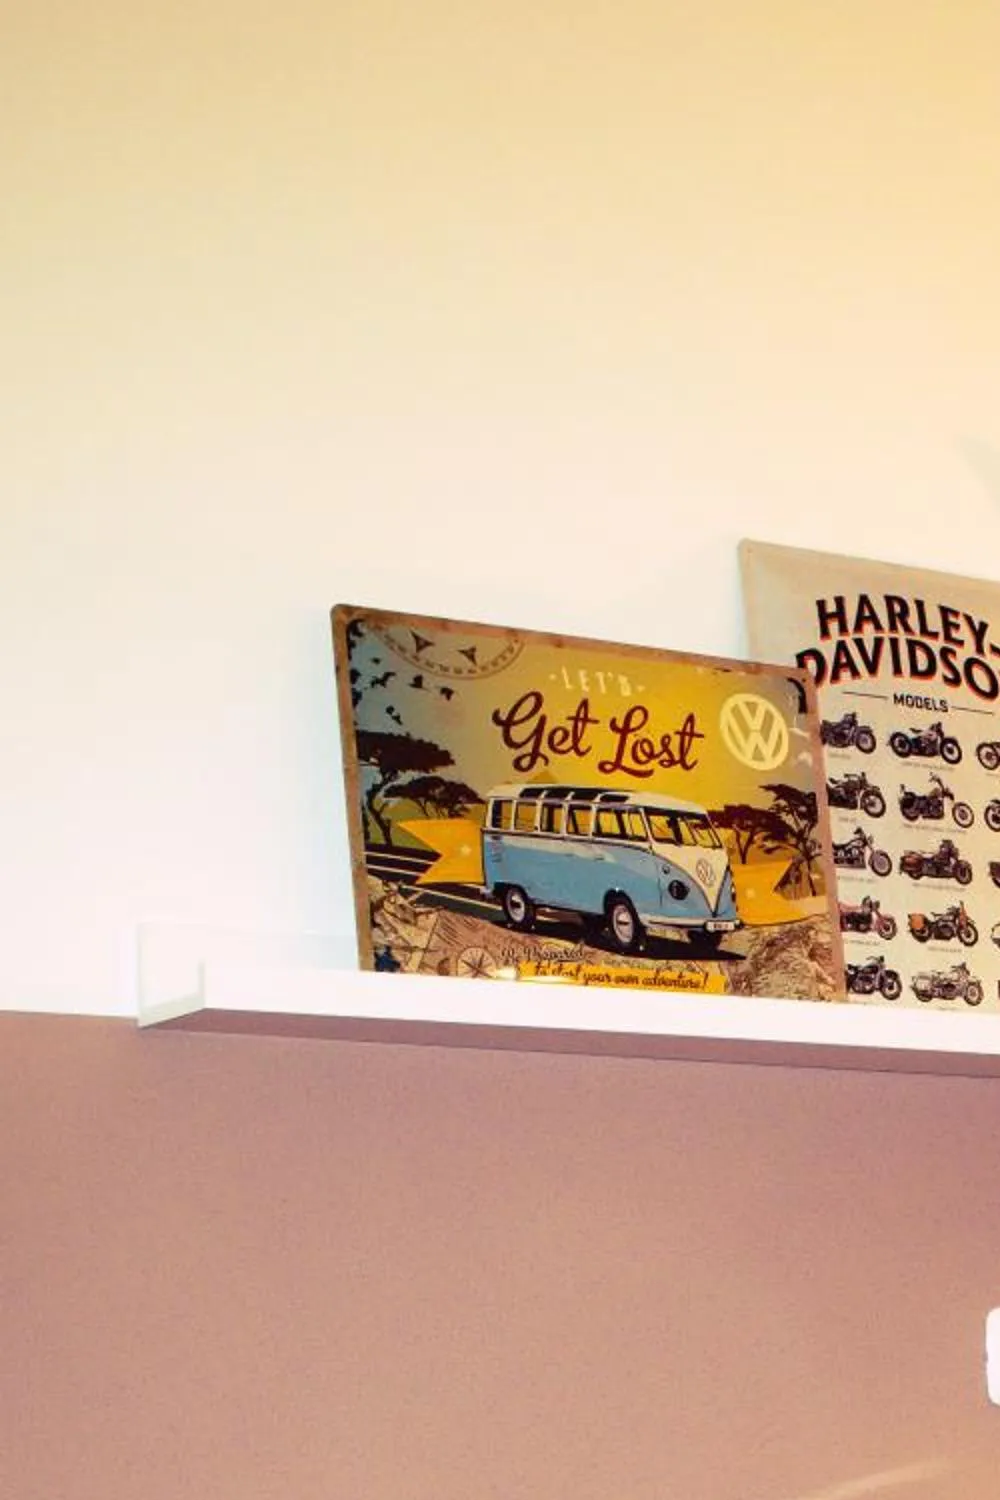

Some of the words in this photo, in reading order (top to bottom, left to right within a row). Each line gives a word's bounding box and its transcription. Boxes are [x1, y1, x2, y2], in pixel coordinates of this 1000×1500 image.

[561, 666, 633, 697] LET'S
[893, 693, 949, 713] MODELS
[491, 691, 600, 773] Get
[597, 705, 705, 778] Lost
[583, 971, 612, 986] your
